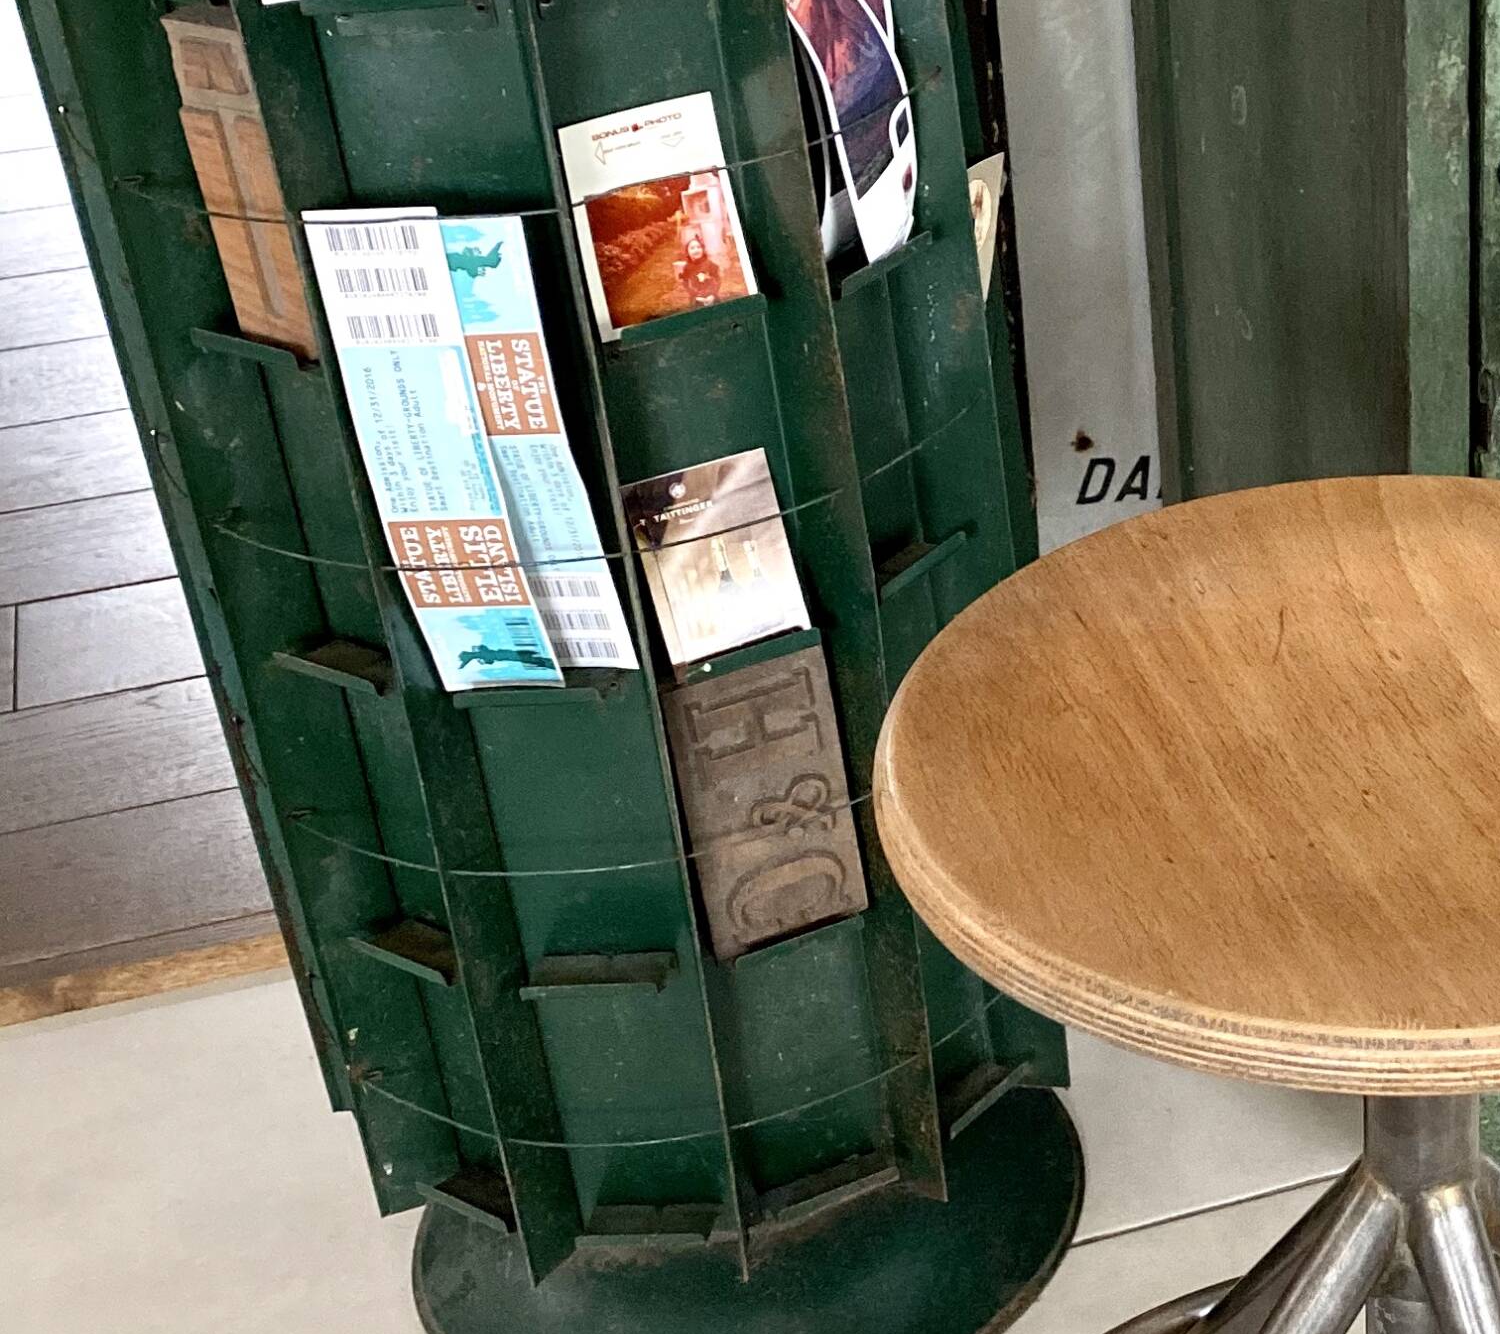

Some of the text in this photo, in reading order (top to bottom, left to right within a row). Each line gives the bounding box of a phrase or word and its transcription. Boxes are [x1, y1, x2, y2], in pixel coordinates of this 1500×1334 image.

[485, 339, 523, 431] LIBERTY
[511, 339, 549, 430] STATUE
[653, 499, 714, 523] TAITTINGER
[1076, 455, 1162, 505] DA
